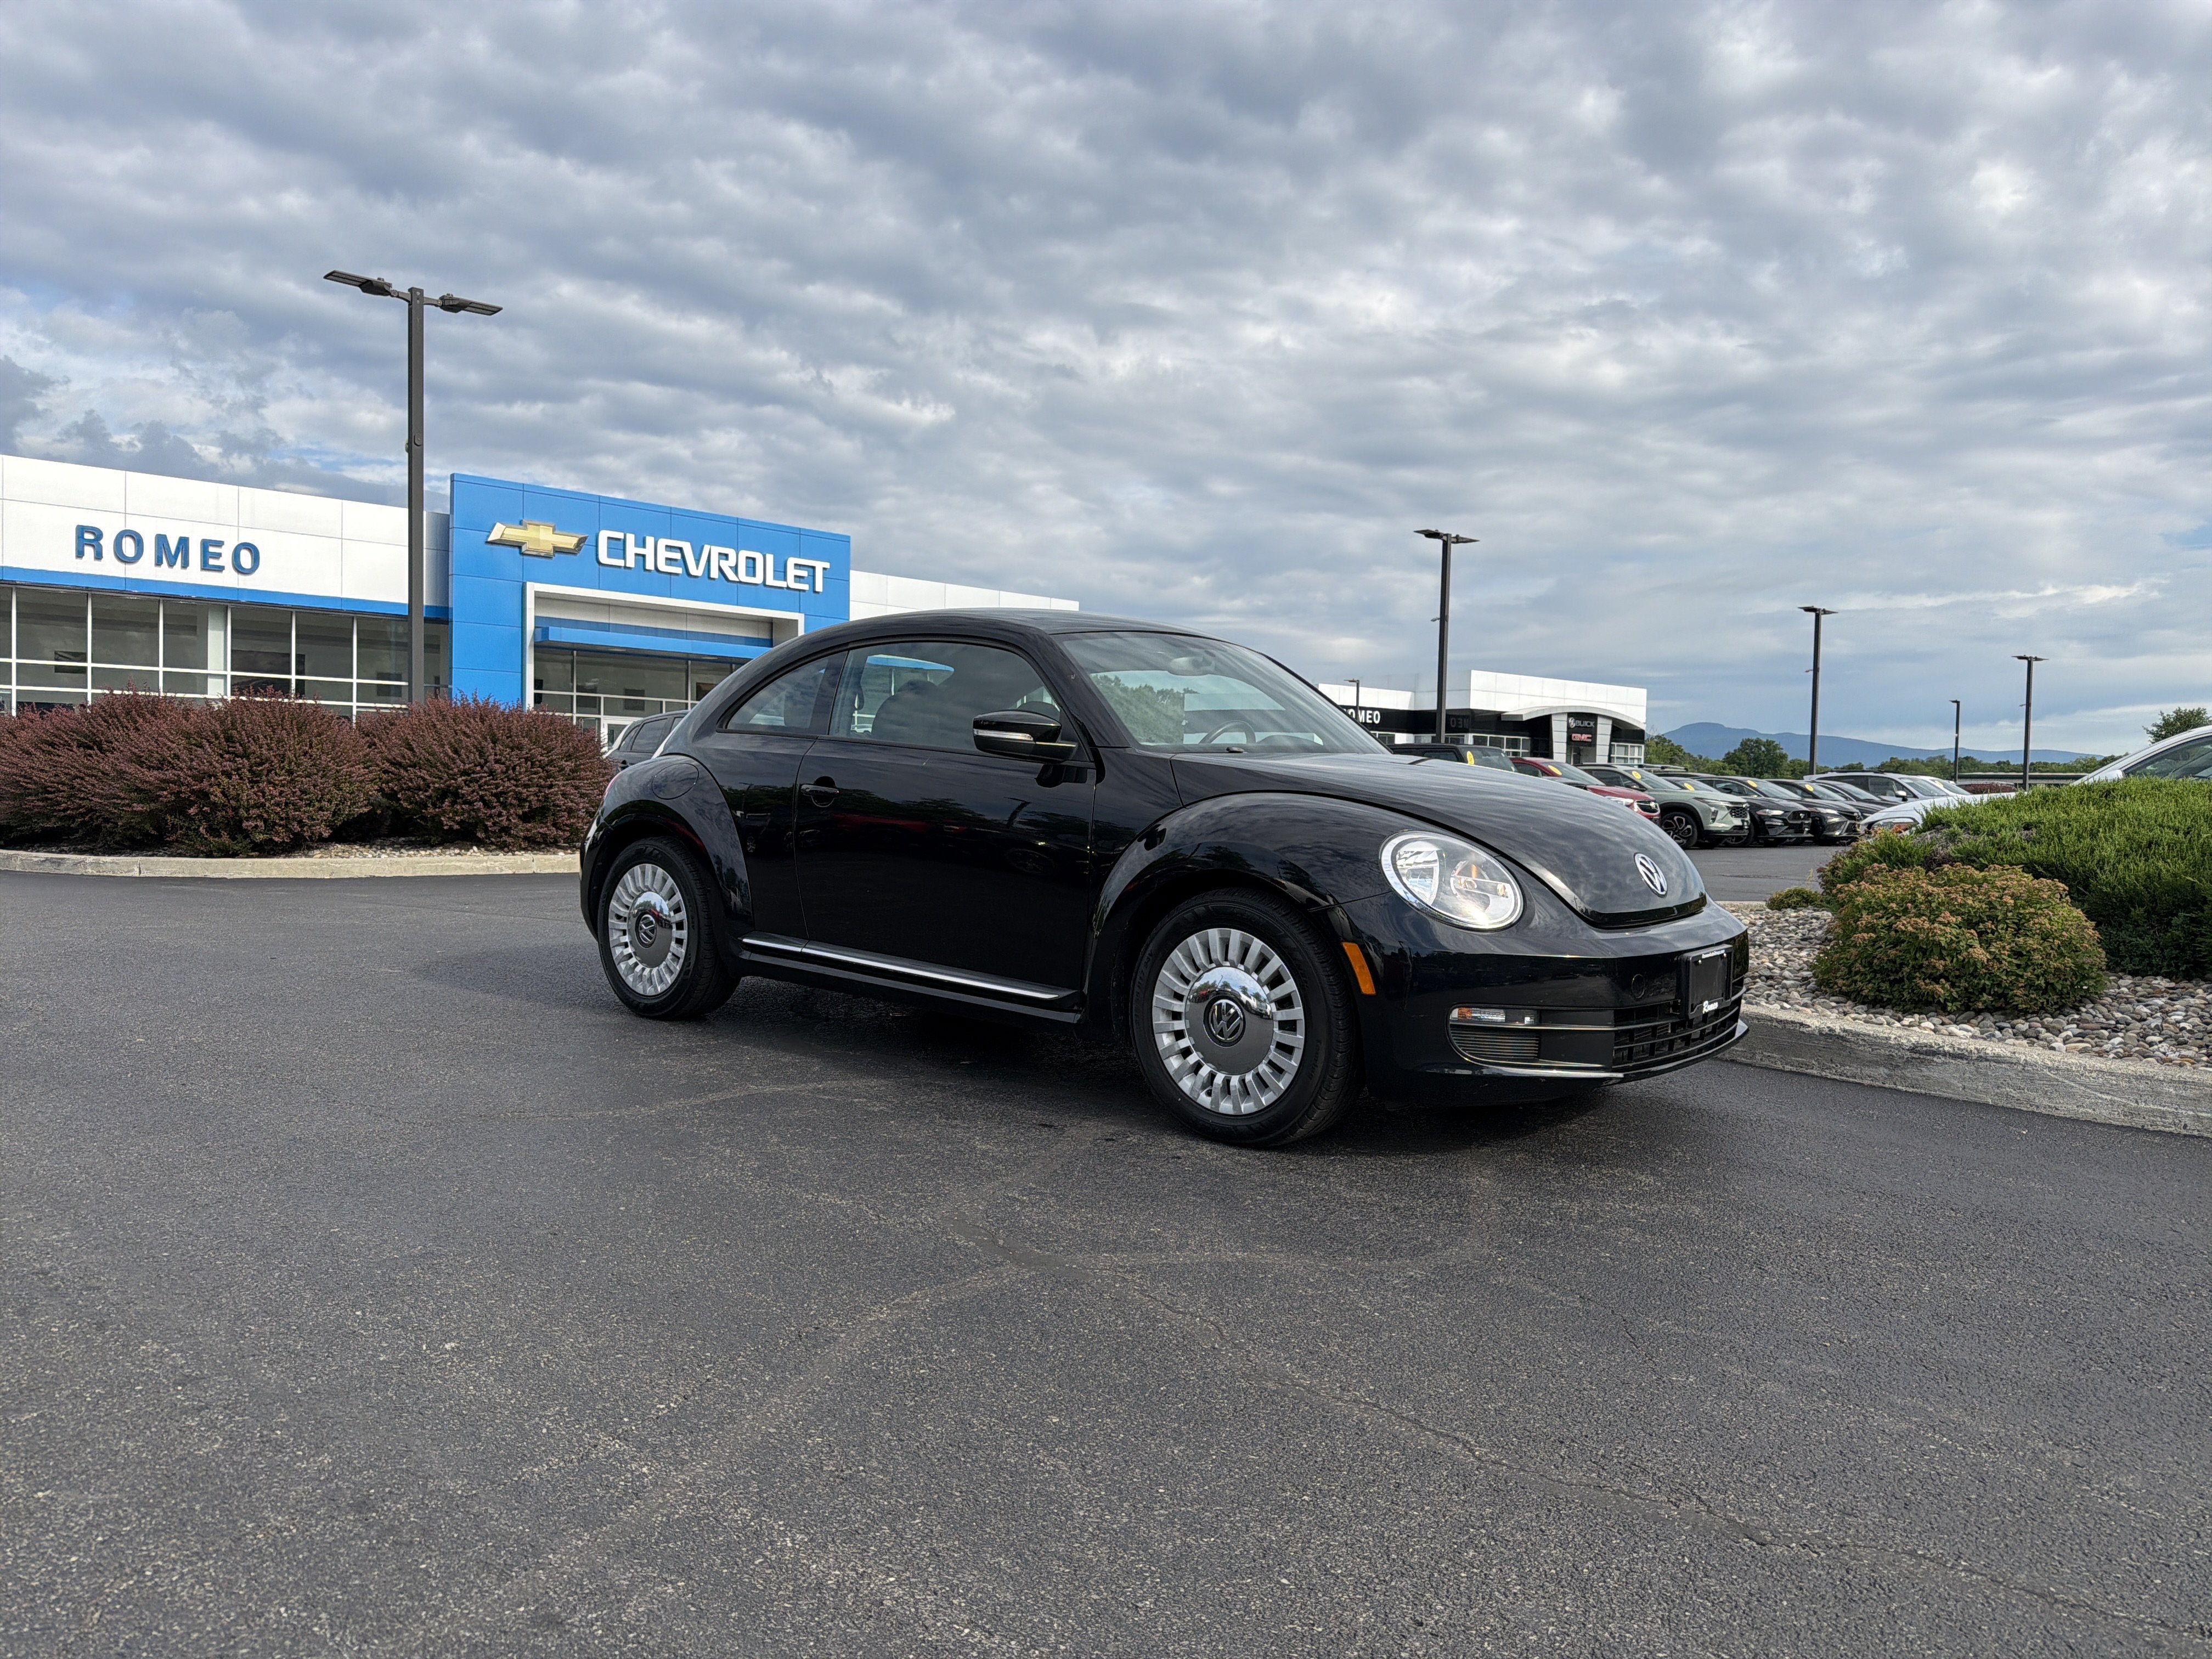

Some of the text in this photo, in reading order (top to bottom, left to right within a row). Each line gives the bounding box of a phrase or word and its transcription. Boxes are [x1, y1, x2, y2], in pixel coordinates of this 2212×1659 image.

[75, 524, 260, 575] ROMEO
[598, 530, 830, 592] CHEVROLET
[1343, 708, 1380, 724] OMEO
[1572, 733, 1592, 742] GMC
